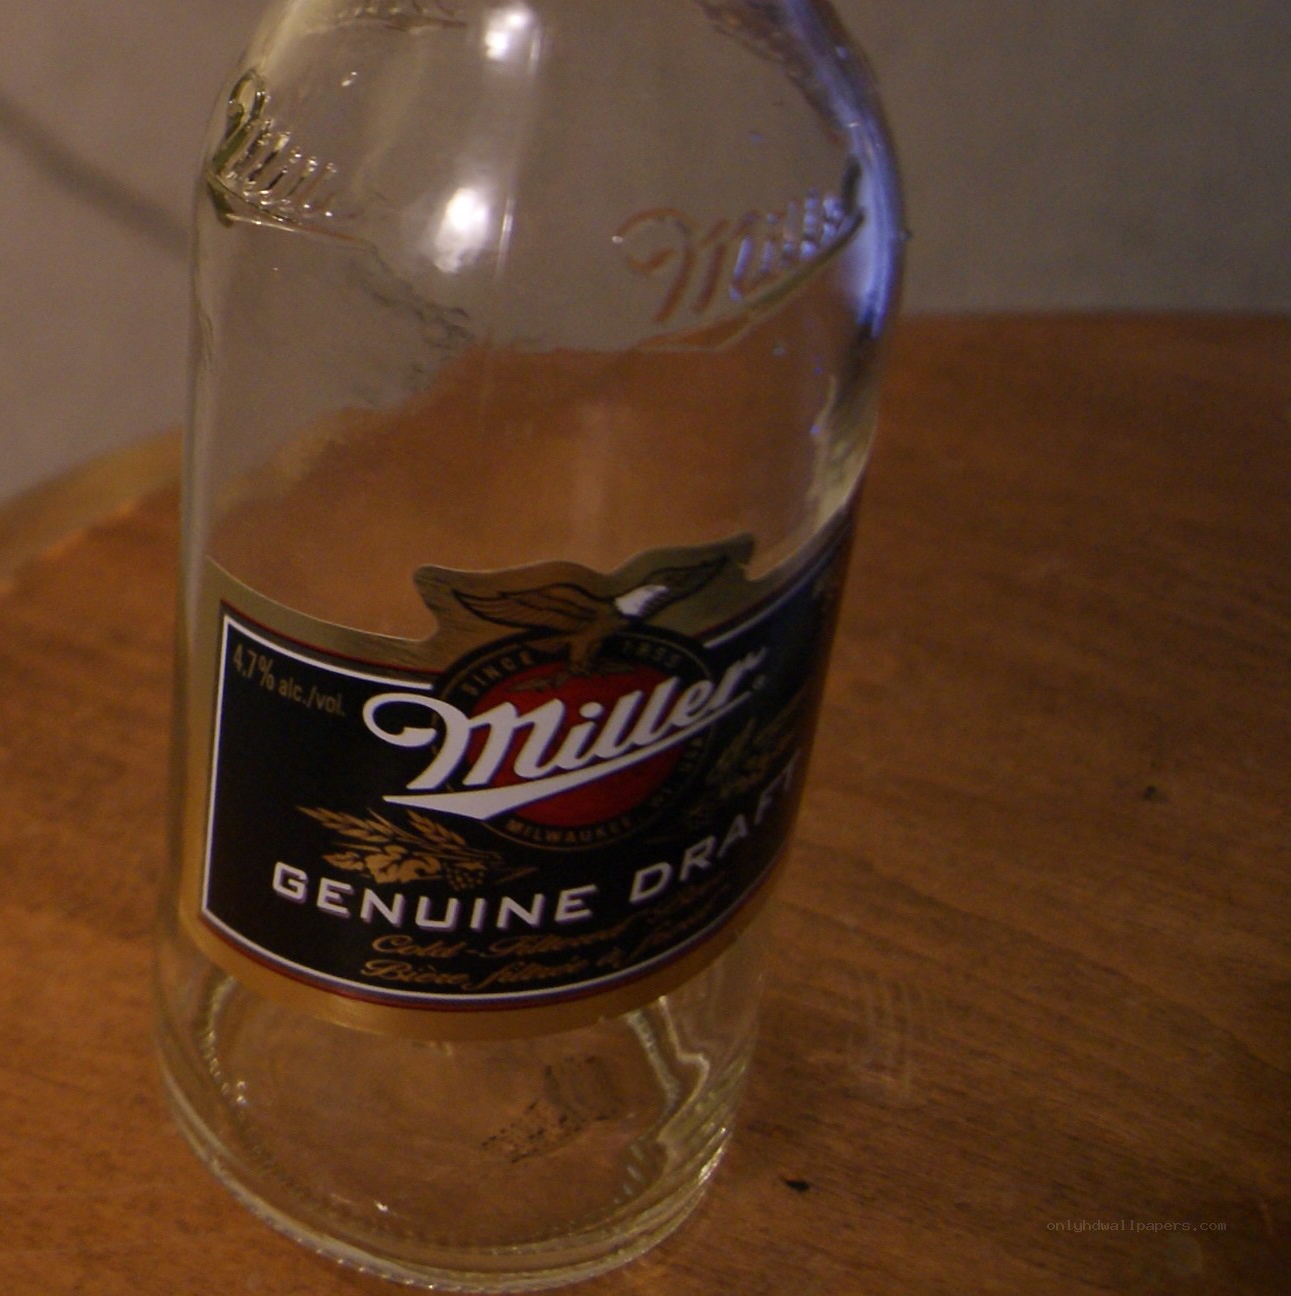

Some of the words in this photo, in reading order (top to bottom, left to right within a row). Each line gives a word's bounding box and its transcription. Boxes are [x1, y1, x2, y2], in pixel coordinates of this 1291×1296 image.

[231, 643, 276, 692] 4.7%
[277, 675, 347, 718] alc./vol.
[362, 647, 767, 818] Miller
[272, 862, 599, 930] GENUINE
[628, 748, 803, 905] DRAFT
